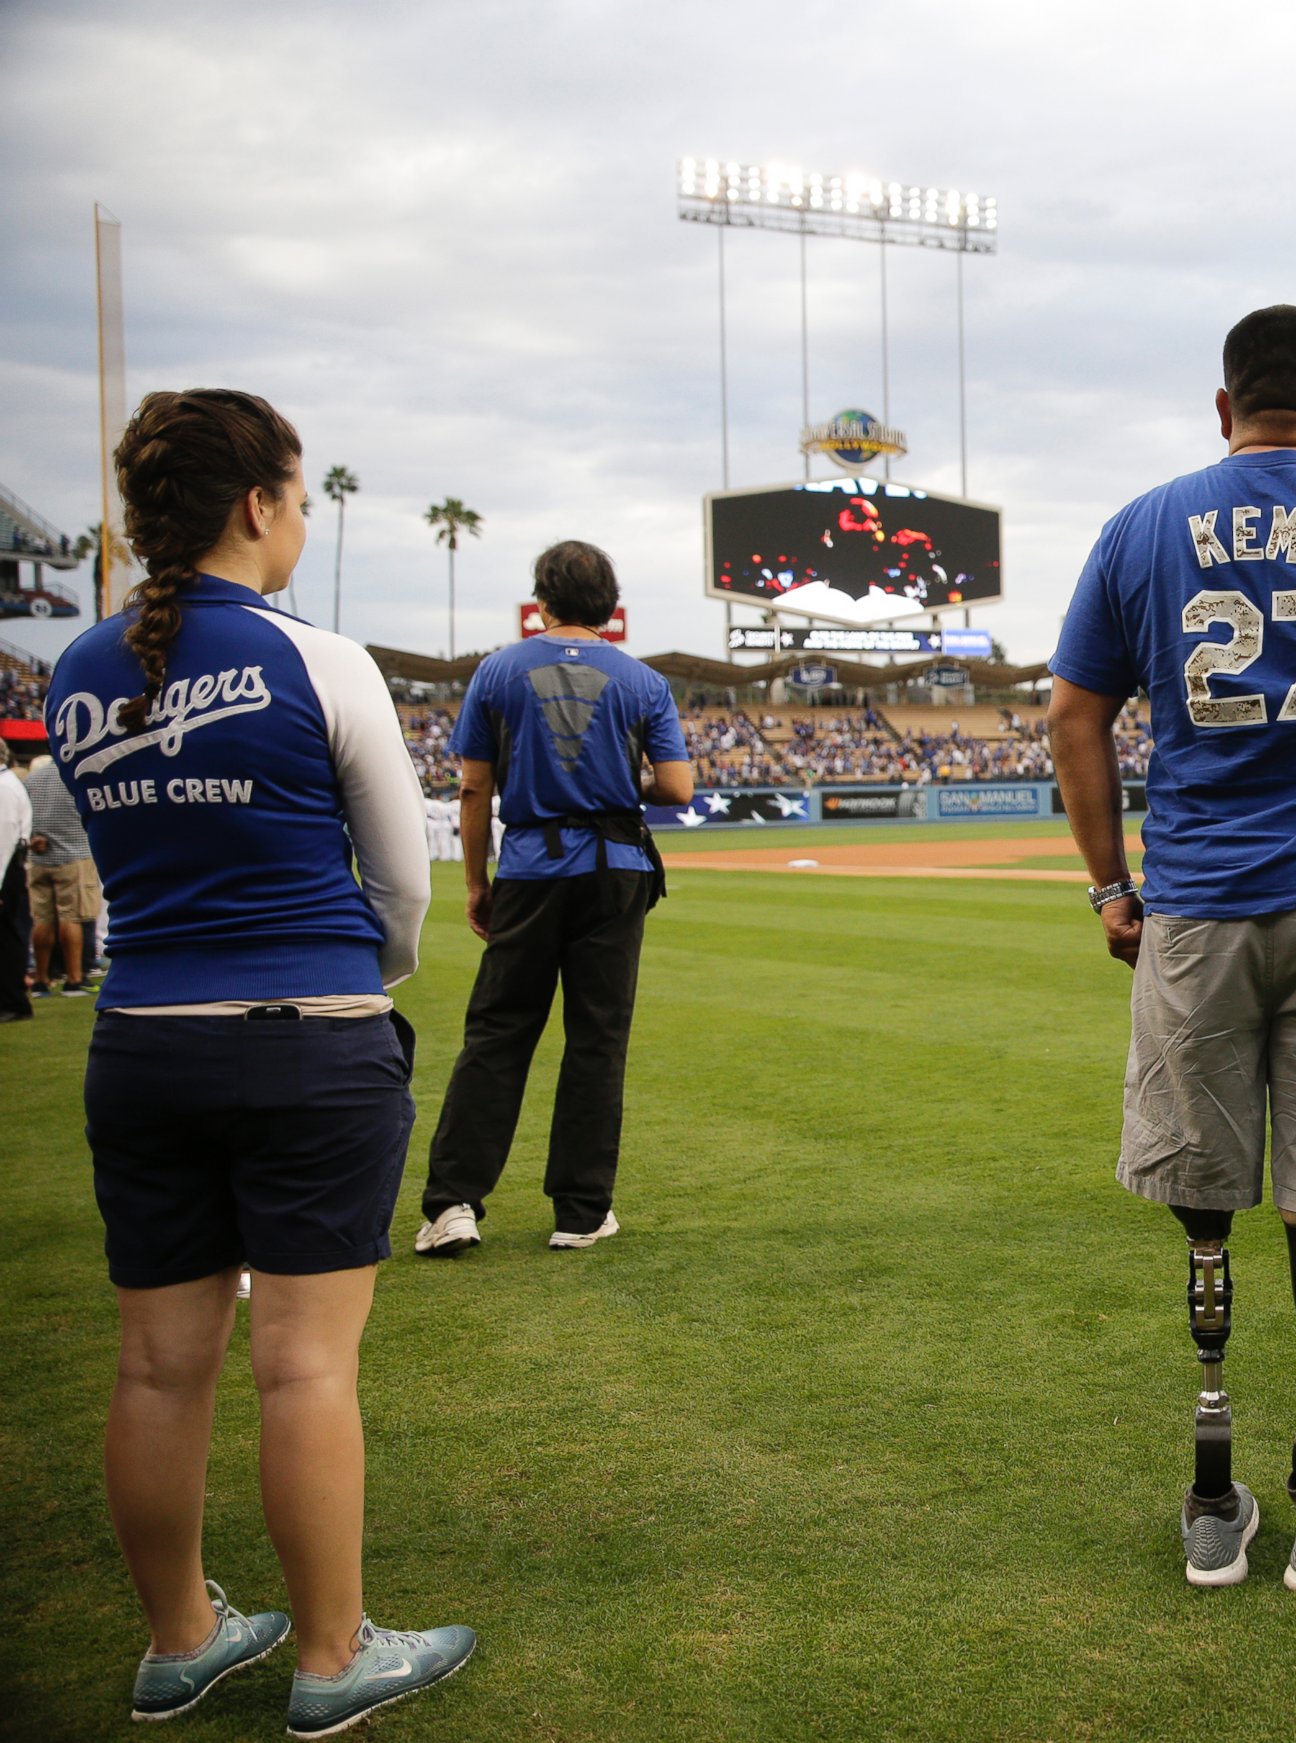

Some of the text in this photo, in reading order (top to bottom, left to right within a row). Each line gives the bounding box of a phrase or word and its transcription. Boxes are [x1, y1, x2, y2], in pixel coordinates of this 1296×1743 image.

[55, 665, 272, 779] Dogers
[86, 778, 254, 812] BLUE CREW
[939, 790, 1036, 804] SAN MANUEL
